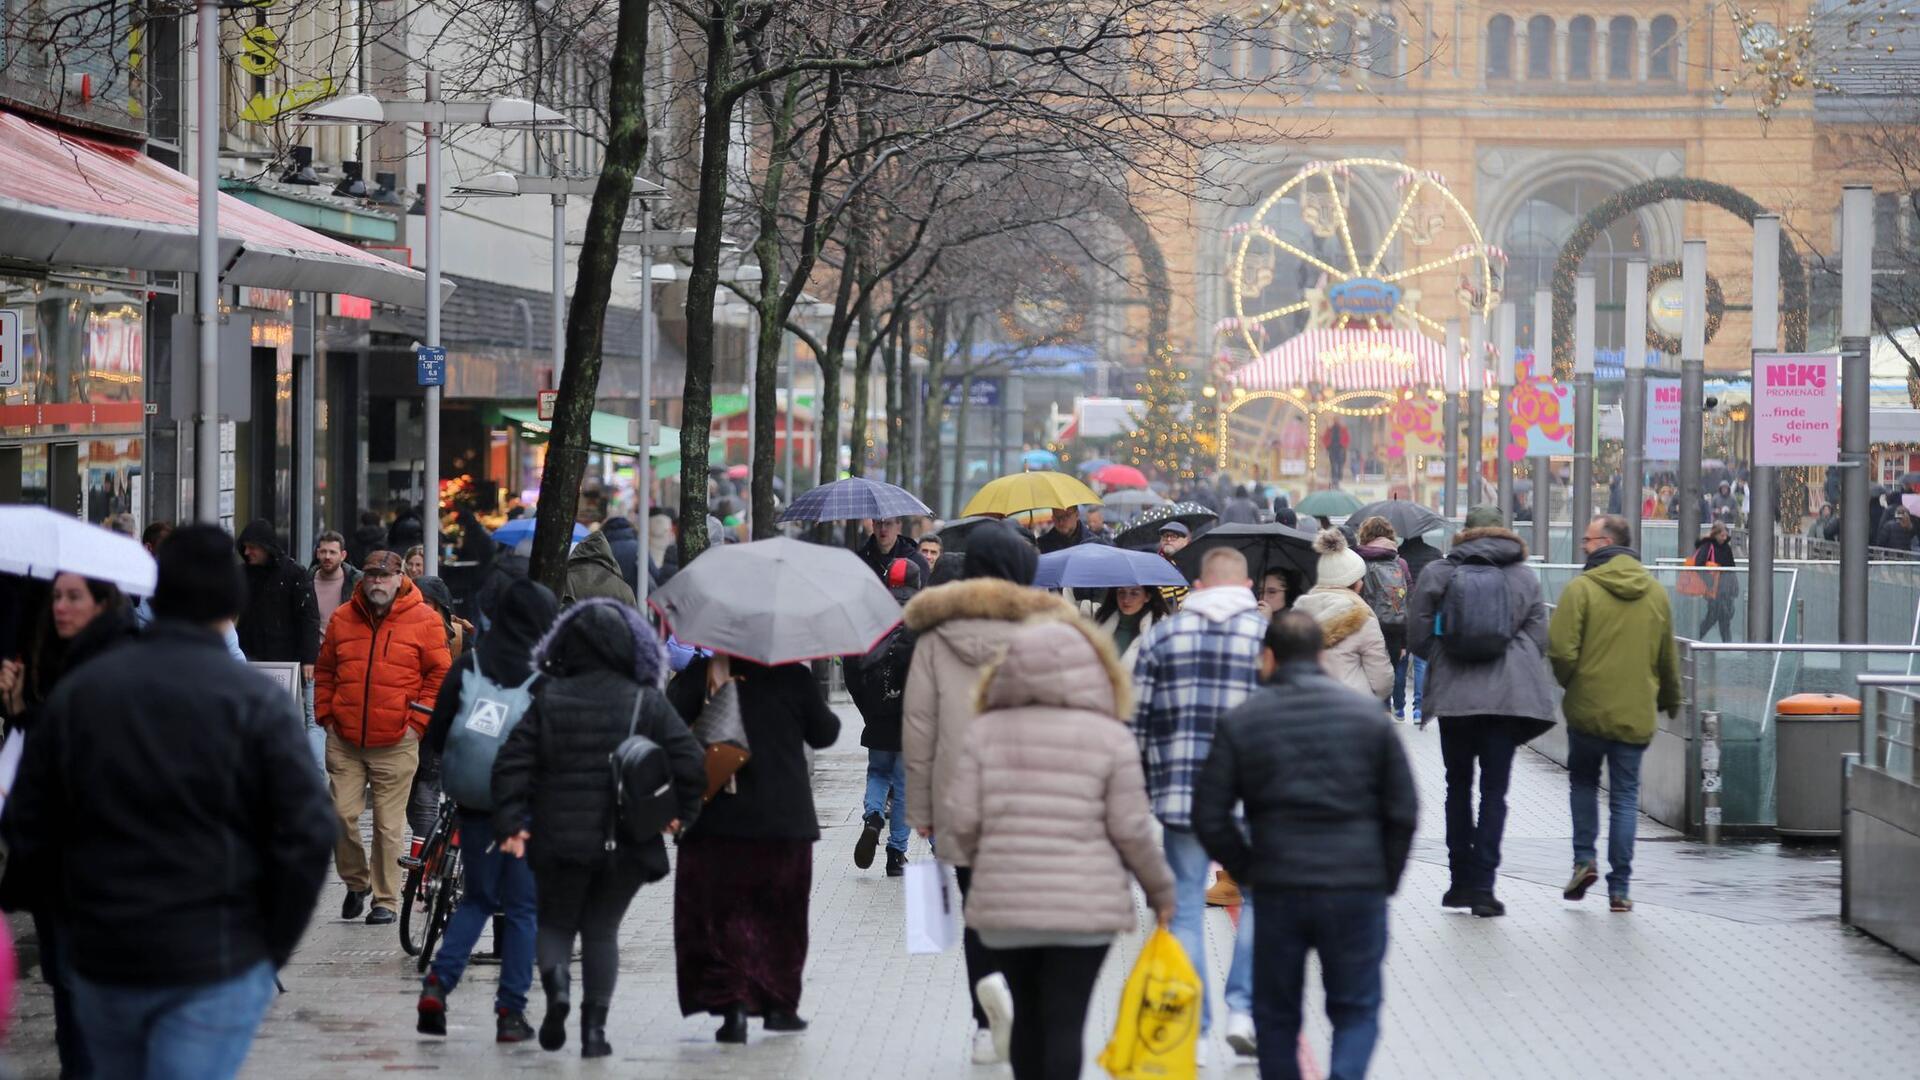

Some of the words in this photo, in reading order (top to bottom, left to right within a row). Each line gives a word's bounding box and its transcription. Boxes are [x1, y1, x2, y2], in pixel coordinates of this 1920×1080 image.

[1766, 388, 1826, 397] PROMENADE
[1786, 420, 1829, 431] deinen
[1771, 432, 1803, 446] Style
